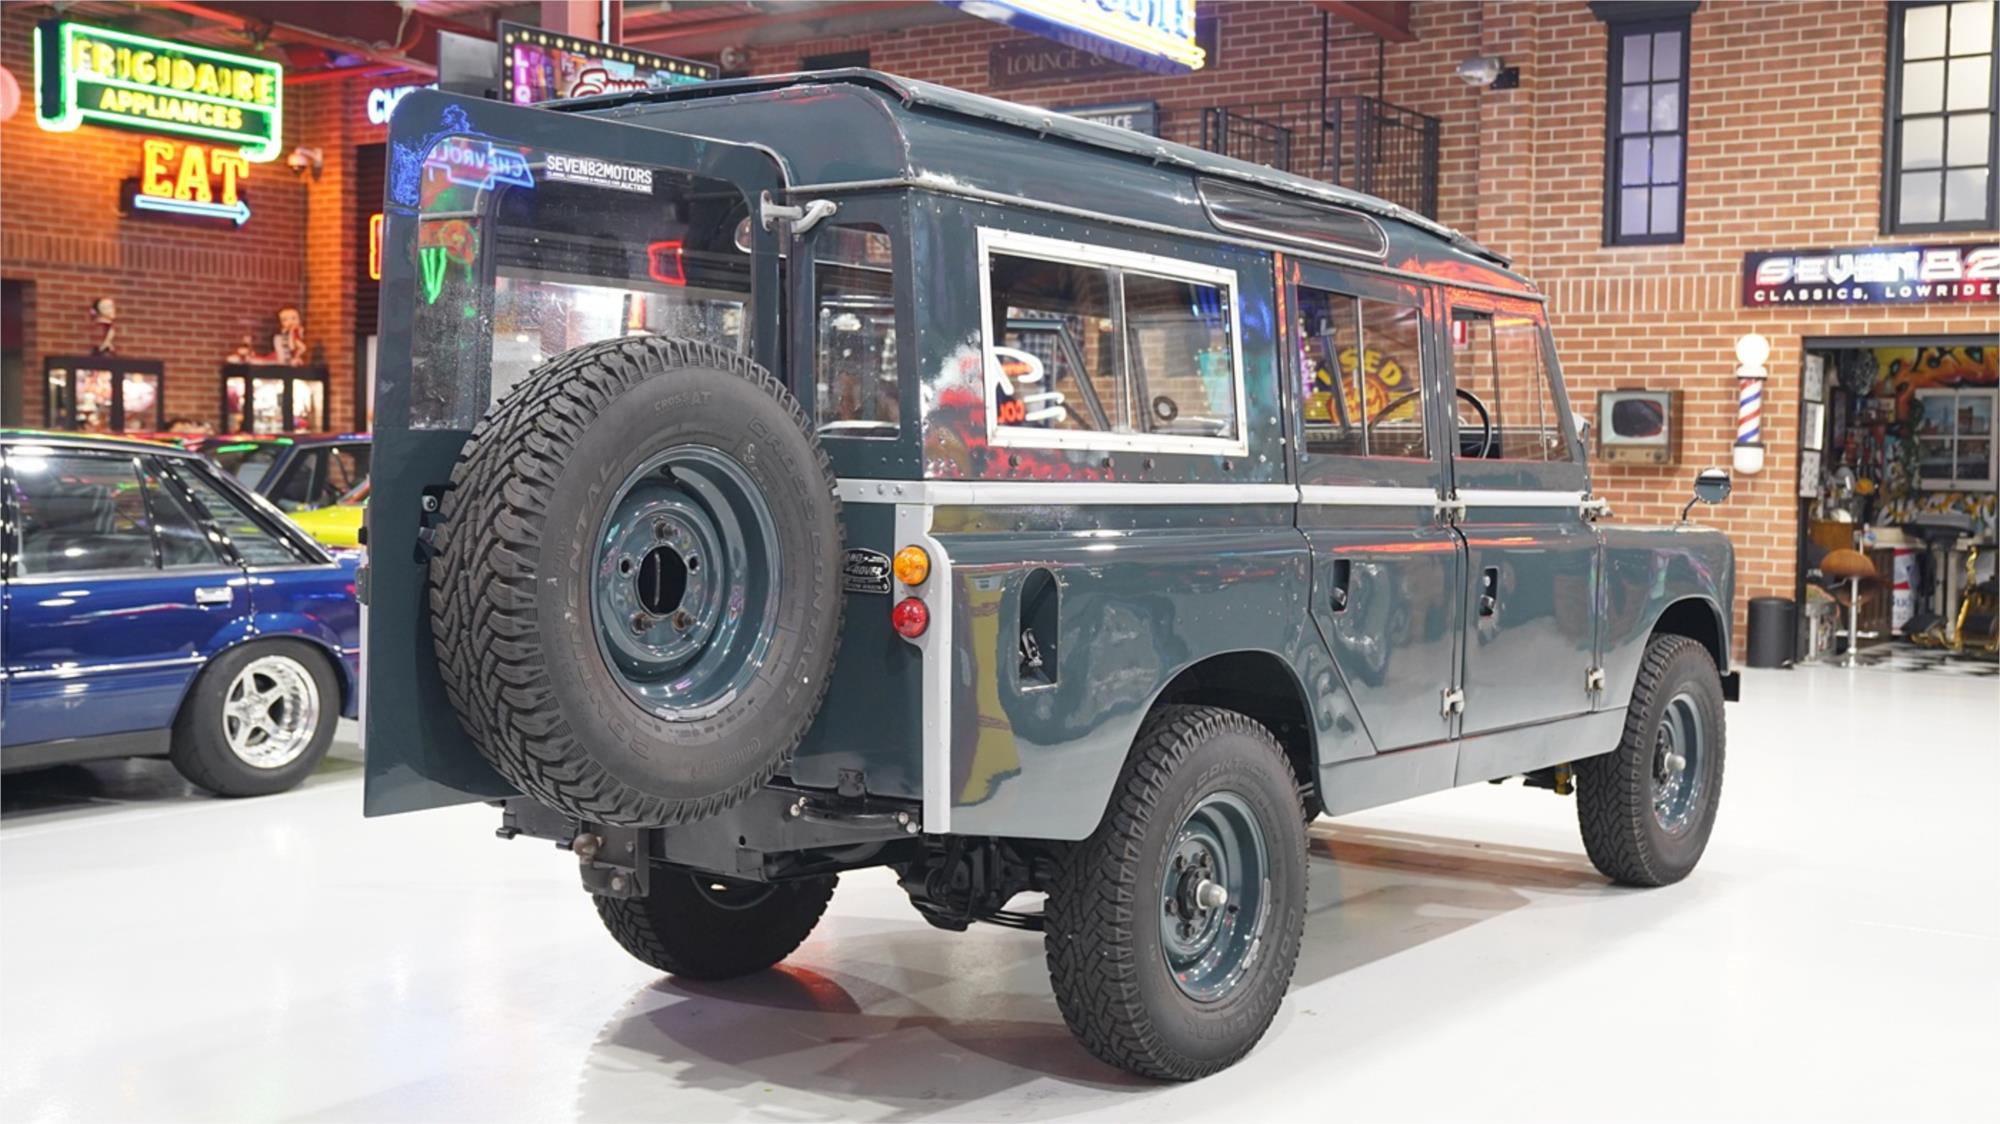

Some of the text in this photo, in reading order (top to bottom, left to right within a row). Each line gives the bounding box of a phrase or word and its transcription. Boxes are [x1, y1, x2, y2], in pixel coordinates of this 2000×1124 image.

[72, 38, 276, 104] FRIGIDAIRE
[1007, 49, 1080, 76] LOUNGE
[100, 88, 242, 129] APPLIANCES
[143, 139, 249, 205] EAT
[547, 154, 653, 185] SEVEN82MOTORS
[1754, 283, 2000, 301] CLASSICS, LOWRIDE
